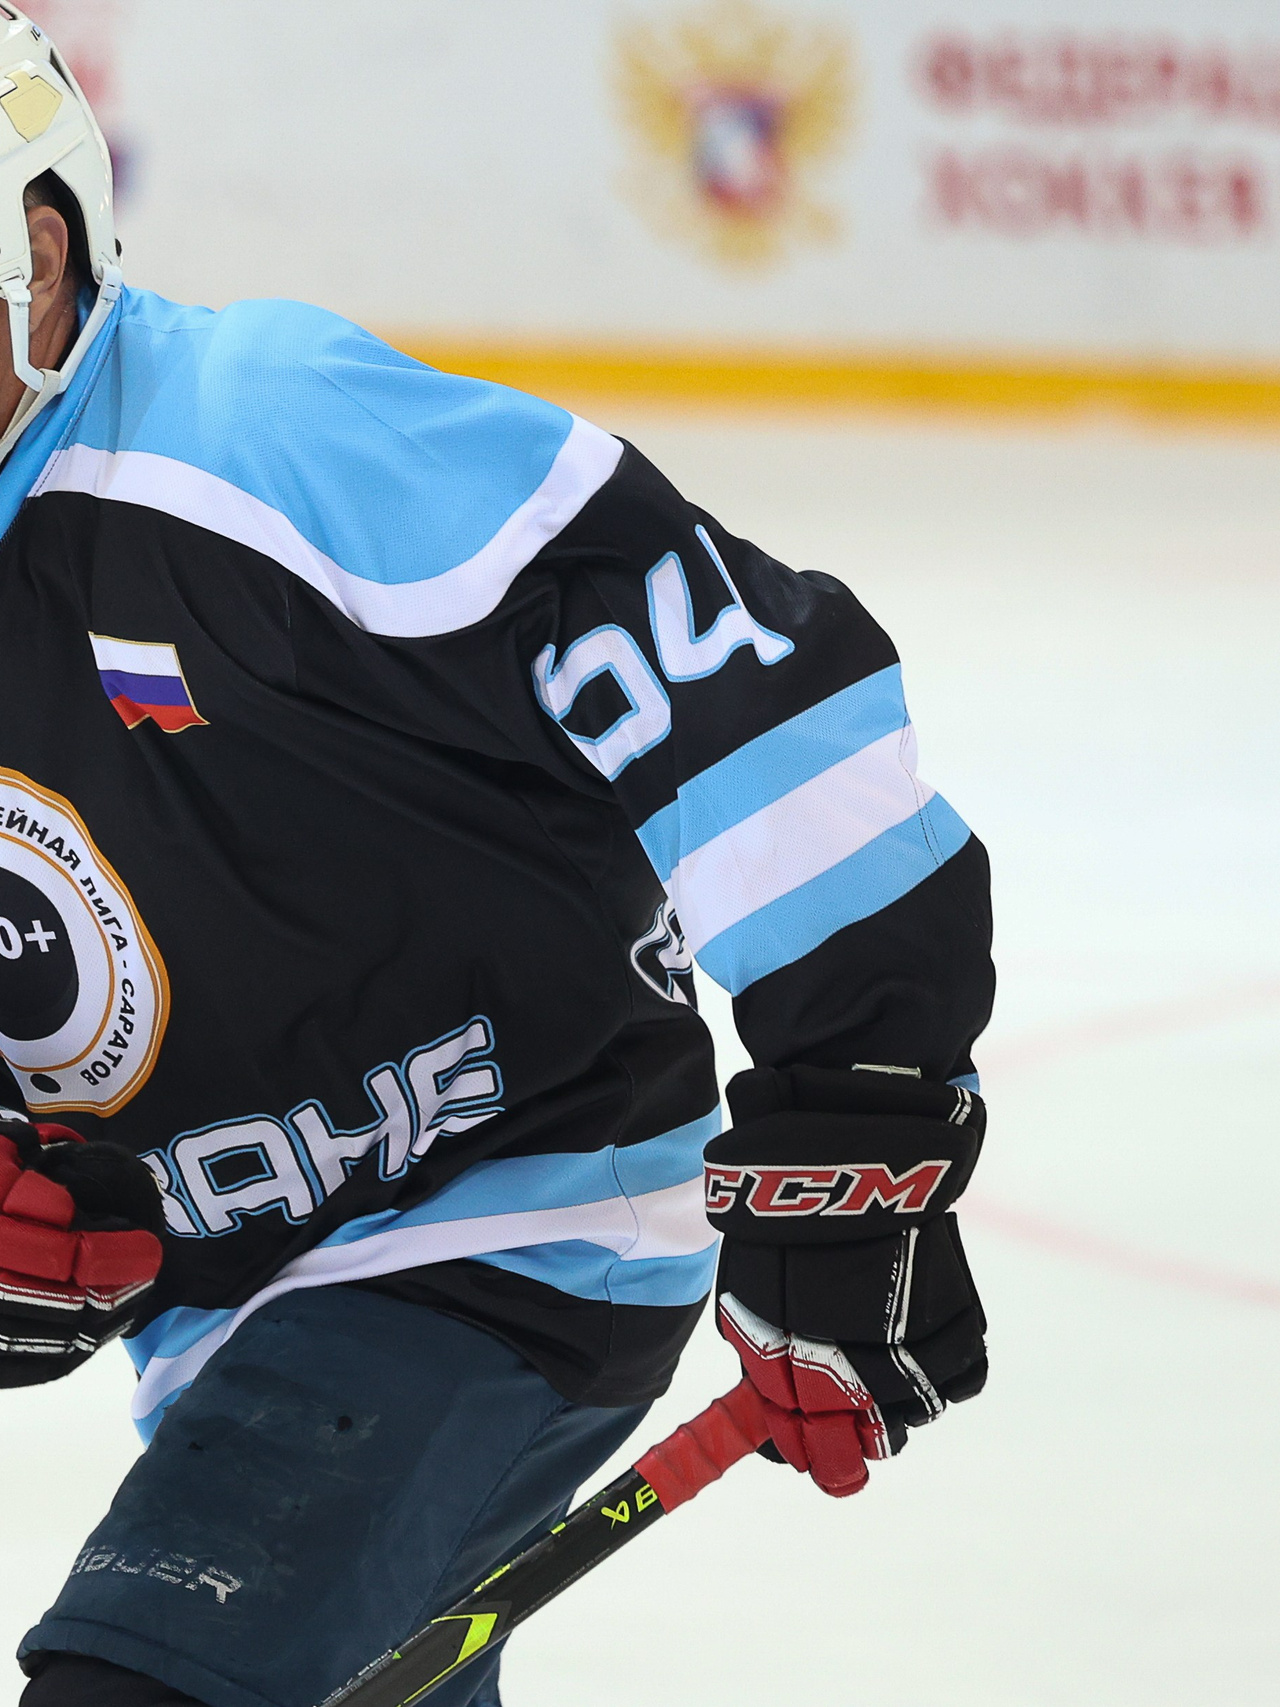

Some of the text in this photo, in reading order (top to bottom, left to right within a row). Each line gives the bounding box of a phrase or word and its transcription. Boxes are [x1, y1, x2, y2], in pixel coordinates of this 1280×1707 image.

[80, 876, 129, 951] ЛИГА
[79, 978, 136, 1086] САРАТОВ
[704, 1160, 952, 1217] CCM
